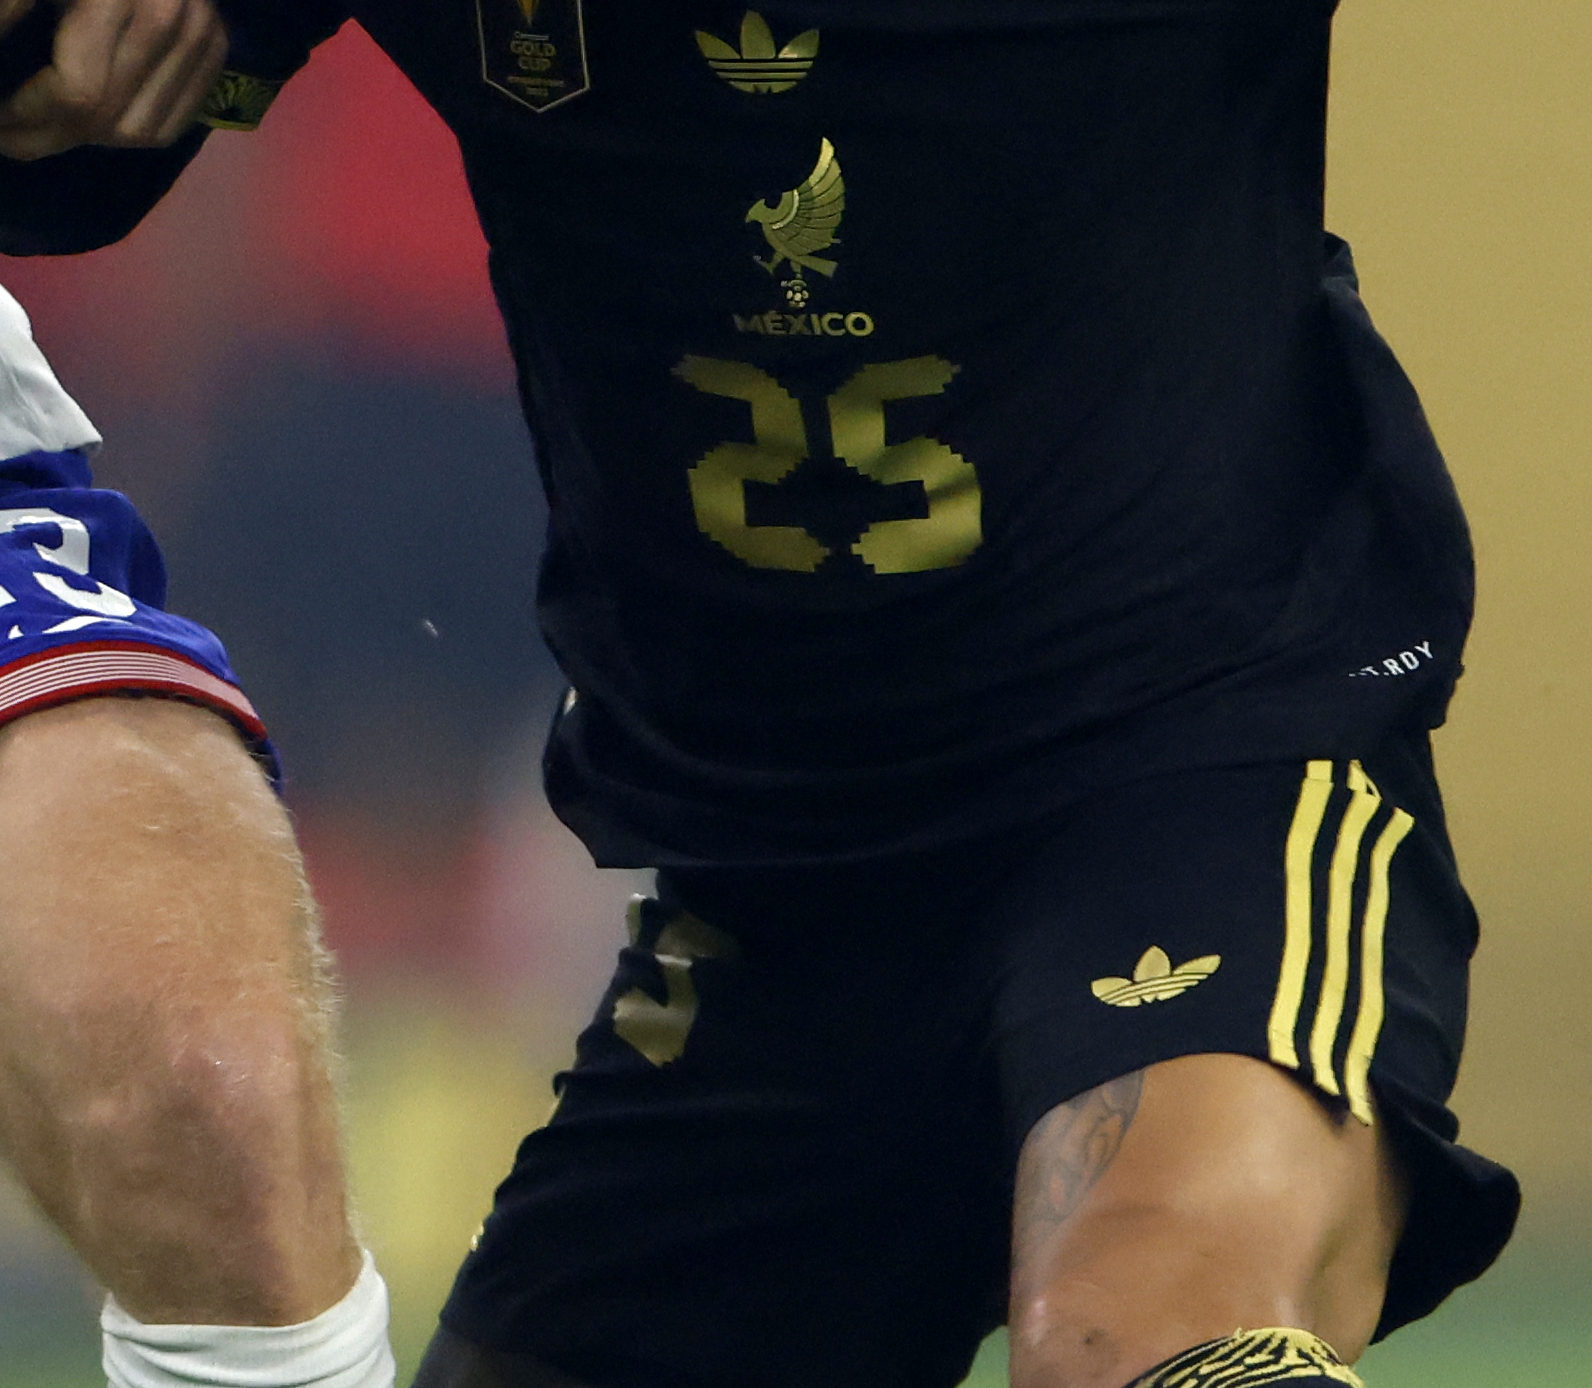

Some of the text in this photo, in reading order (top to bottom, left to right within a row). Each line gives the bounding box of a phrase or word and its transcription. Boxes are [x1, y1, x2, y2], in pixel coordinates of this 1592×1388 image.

[510, 39, 558, 57] GOLD
[732, 309, 876, 338] MÉXICO
[669, 353, 984, 575] 25
